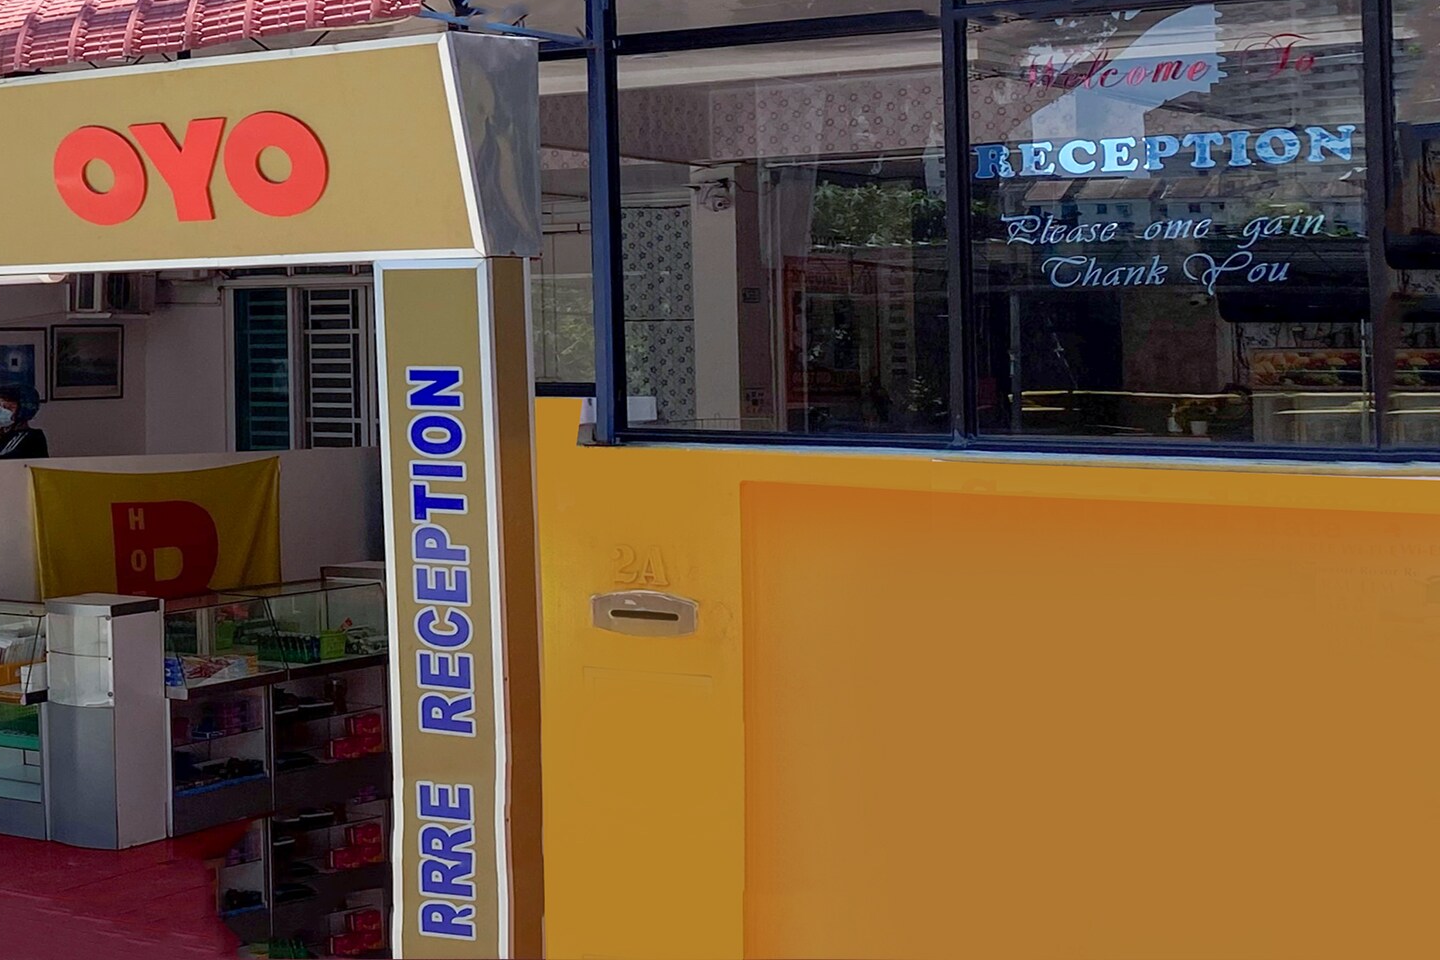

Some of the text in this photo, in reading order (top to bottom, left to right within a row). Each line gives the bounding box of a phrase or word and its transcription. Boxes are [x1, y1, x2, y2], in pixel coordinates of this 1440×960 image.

[1021, 48, 1215, 92] Welcome
[53, 110, 329, 226] OYO
[972, 124, 1357, 180] RECEPTION
[1001, 213, 1119, 246] Please
[1041, 251, 1291, 296] Thank You
[405, 365, 476, 737] RECEPTION
[610, 543, 671, 587] 2A
[418, 781, 476, 941] RRRE
